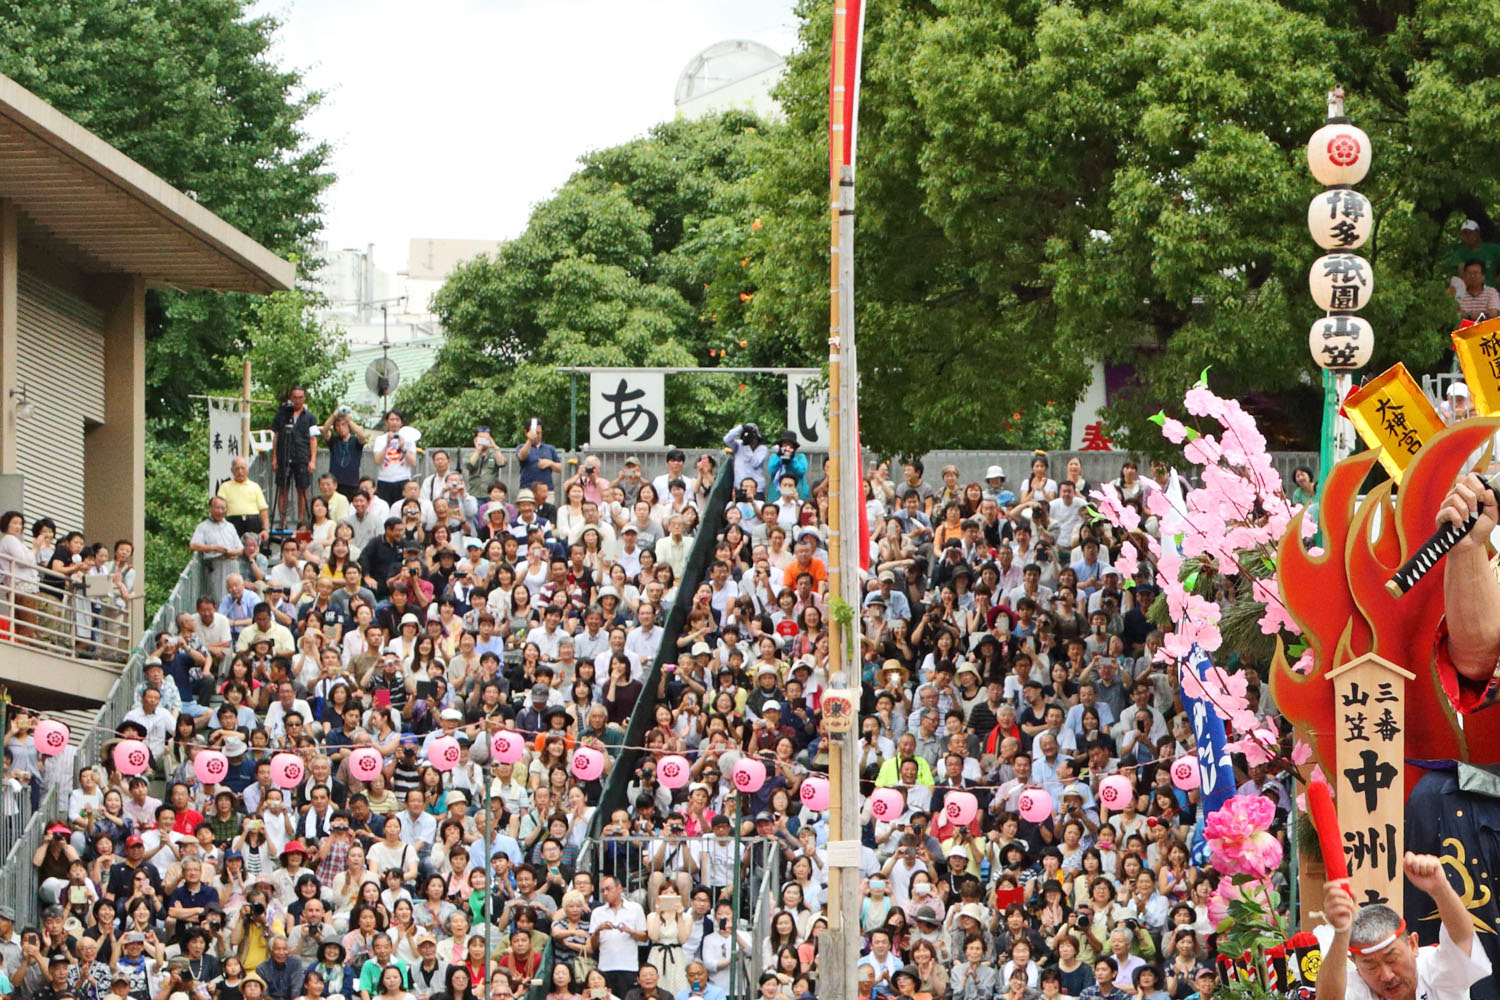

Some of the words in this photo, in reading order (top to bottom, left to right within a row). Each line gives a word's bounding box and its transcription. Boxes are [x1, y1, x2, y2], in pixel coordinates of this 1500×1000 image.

[598, 377, 659, 442] あ
[1375, 397, 1423, 456] 大神宮
[1342, 682, 1370, 742] 山笠
[1374, 682, 1401, 742] 三番
